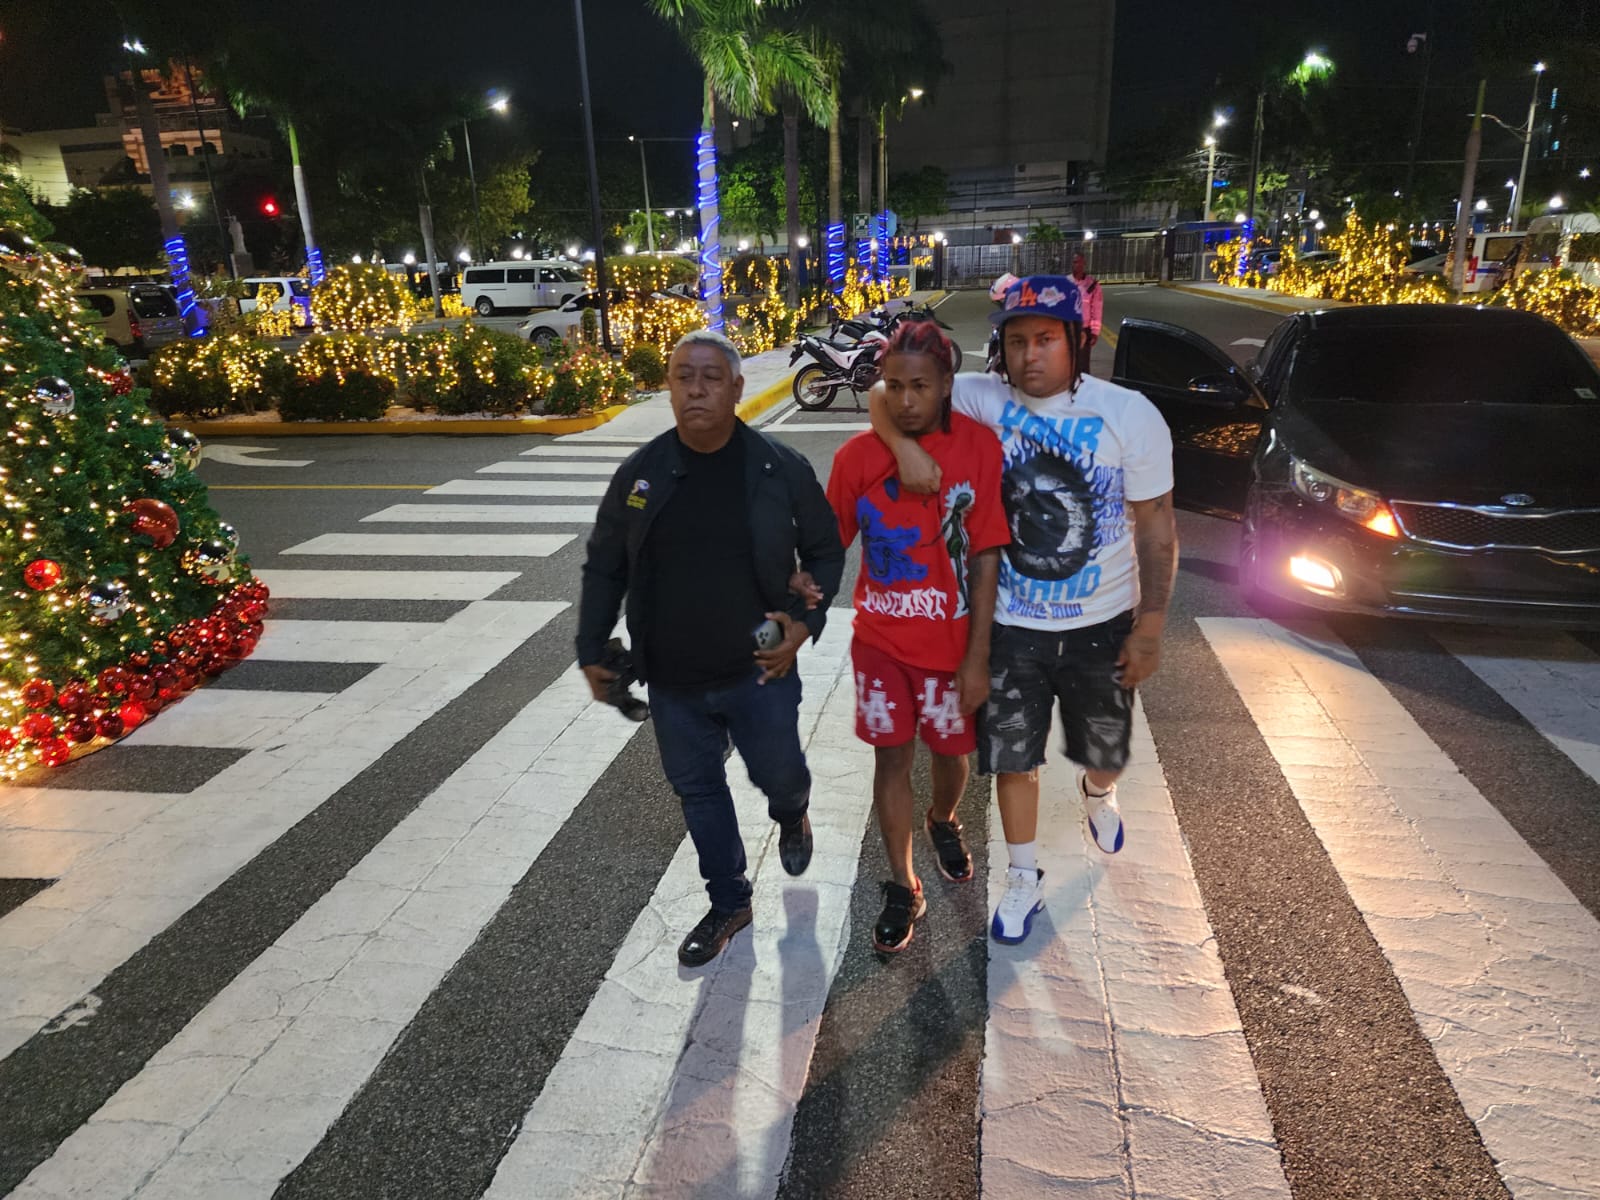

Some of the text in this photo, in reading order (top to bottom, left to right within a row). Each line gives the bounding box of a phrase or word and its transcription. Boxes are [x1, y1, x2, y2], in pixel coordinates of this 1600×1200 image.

[1019, 281, 1037, 307] LA
[998, 400, 1104, 457] YOUR
[857, 672, 894, 733] LA
[922, 678, 965, 734] LA
